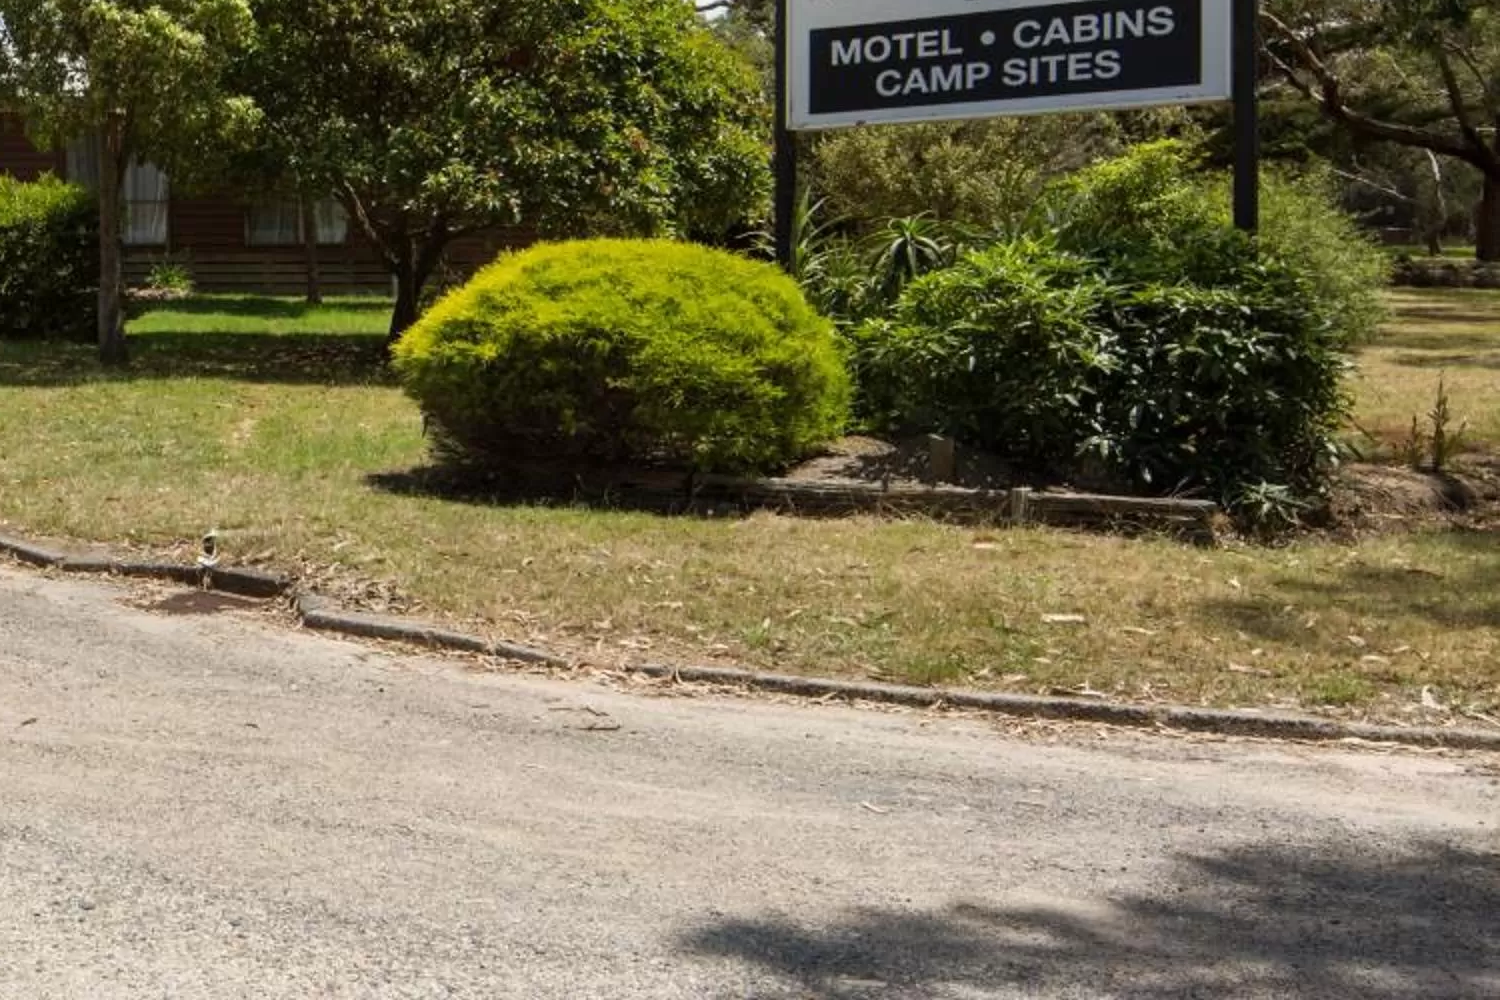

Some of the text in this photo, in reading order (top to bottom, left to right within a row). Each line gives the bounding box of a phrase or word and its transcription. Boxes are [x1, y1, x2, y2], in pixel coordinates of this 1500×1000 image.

[831, 6, 1176, 66] MOTEL CABINS
[875, 49, 1122, 98] CAMP SITES
